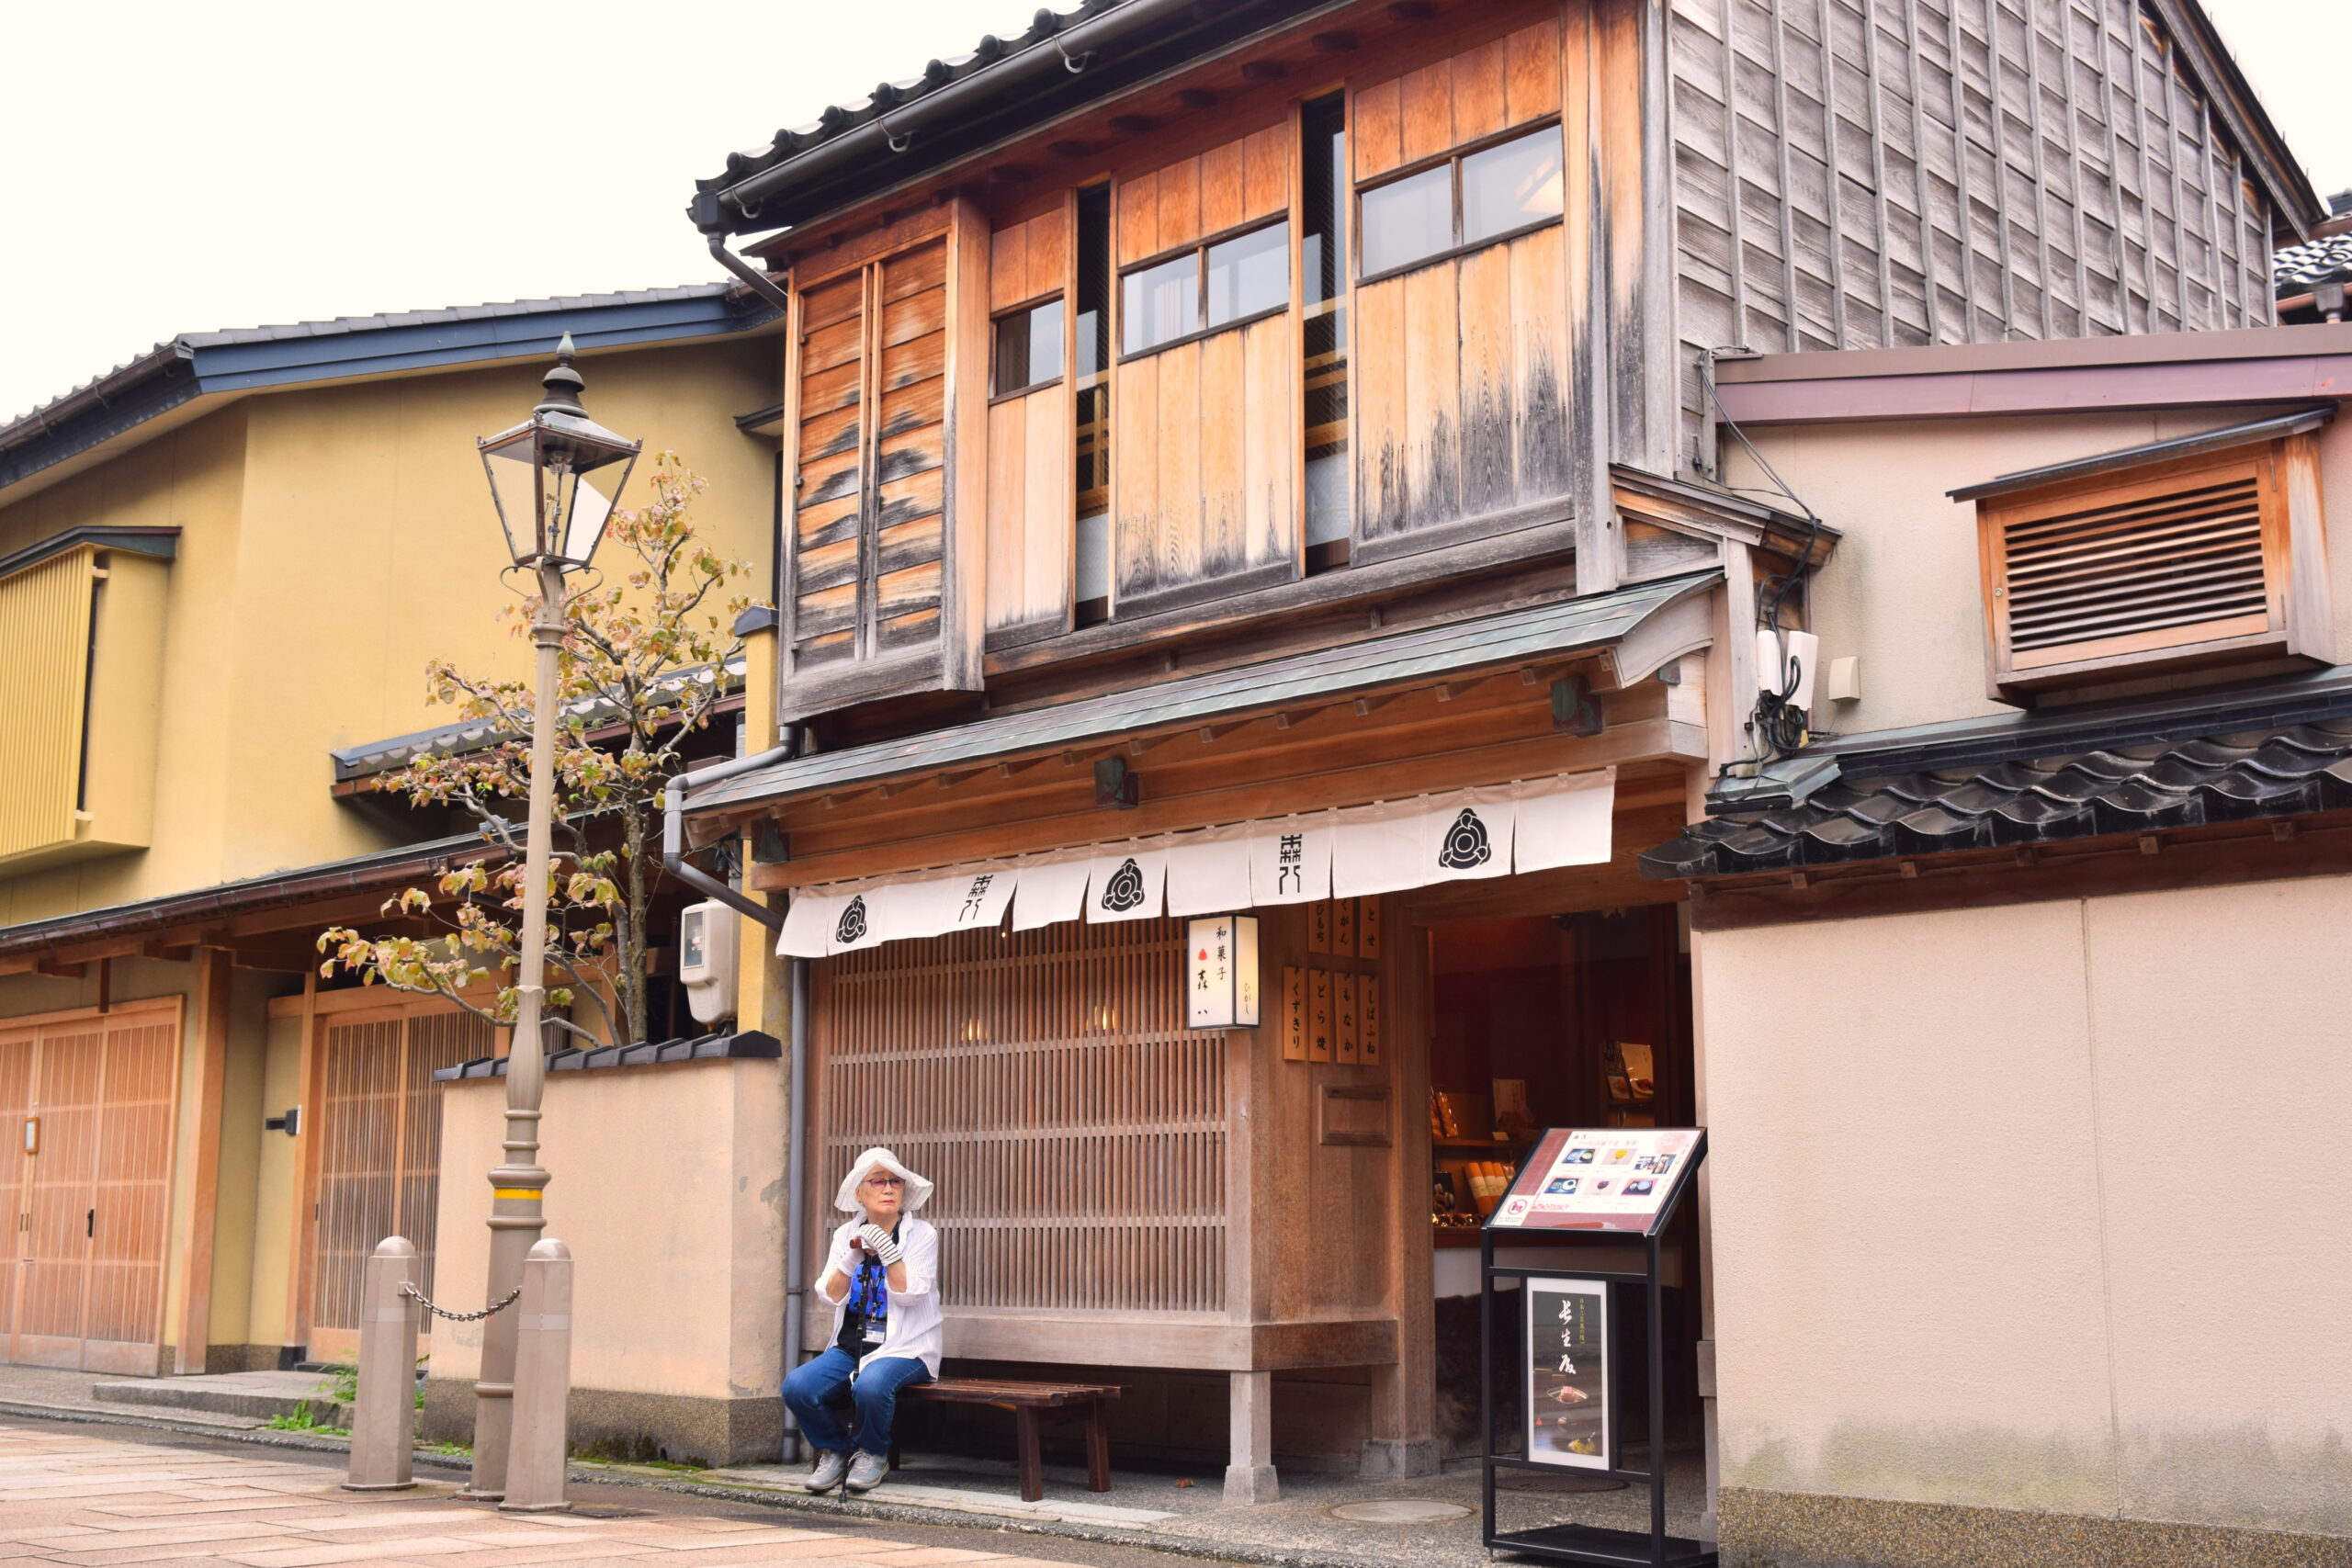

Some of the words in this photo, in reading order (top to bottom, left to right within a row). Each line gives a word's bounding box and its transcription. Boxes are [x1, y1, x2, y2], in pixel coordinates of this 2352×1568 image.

[1316, 902, 1325, 943] びもち
[1340, 898, 1350, 945] くがん
[1366, 907, 1376, 947] とせ
[1216, 926, 1227, 981] 和菓子
[1243, 982, 1252, 1015] ひがし
[1292, 982, 1302, 1049] くずきり
[1316, 984, 1327, 1051] どら焼
[1343, 987, 1353, 1052] もなか
